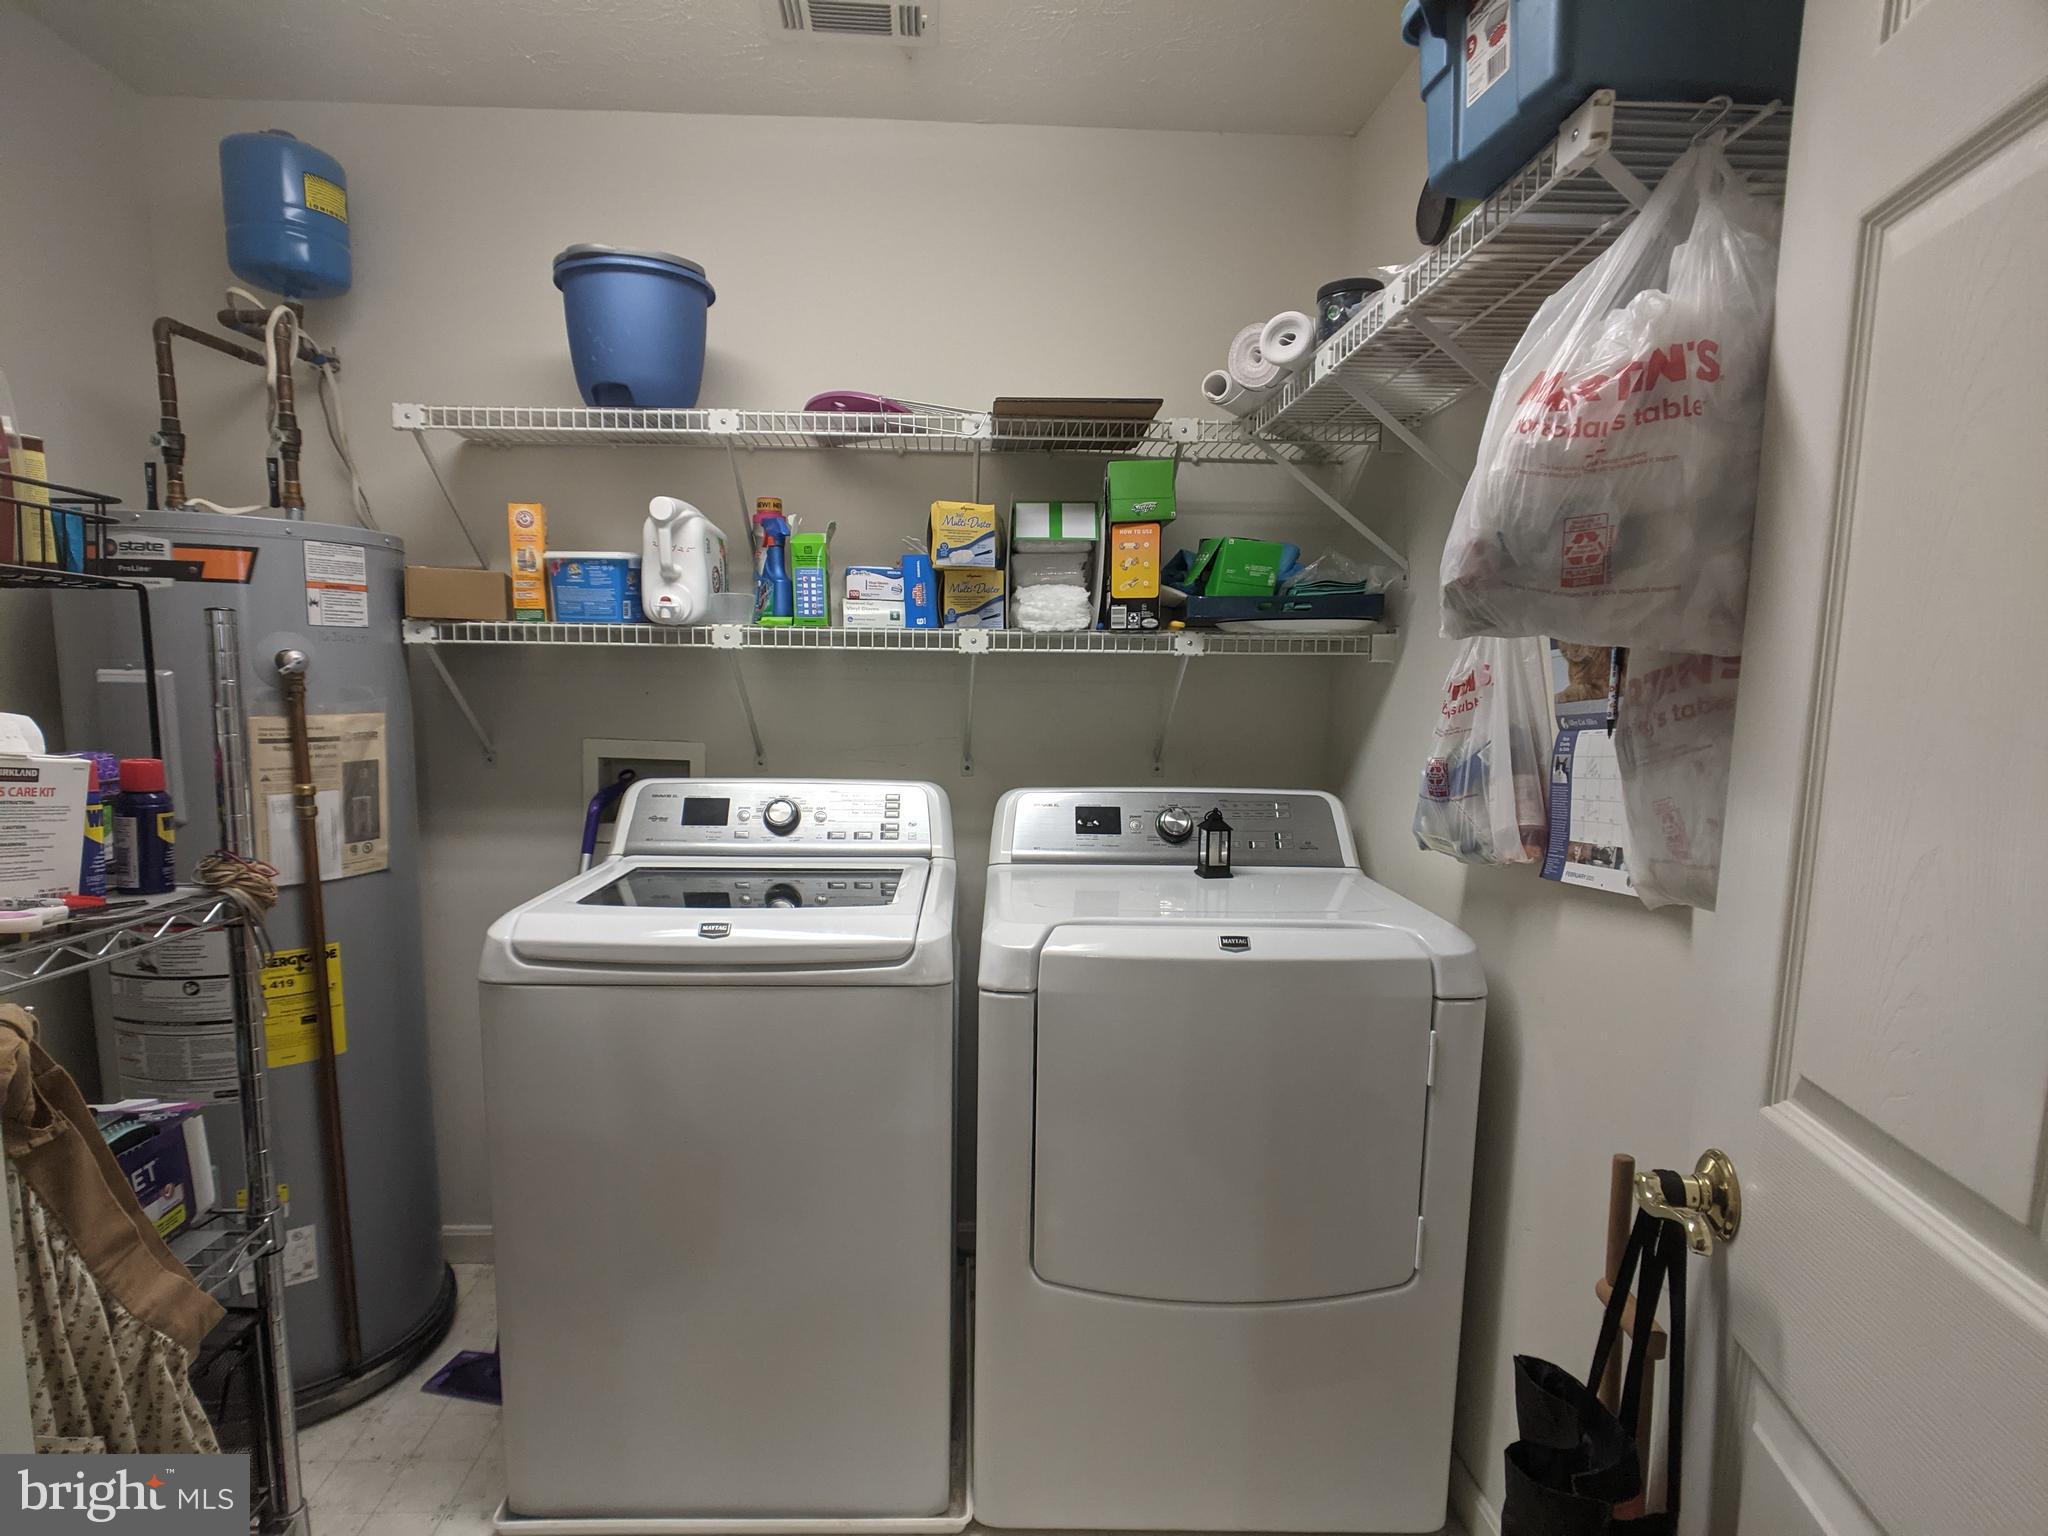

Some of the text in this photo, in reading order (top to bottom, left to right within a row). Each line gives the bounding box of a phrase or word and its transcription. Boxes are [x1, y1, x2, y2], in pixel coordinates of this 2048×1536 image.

[1633, 394, 1703, 427] table
[941, 514, 993, 528] Multi-Duster
[119, 541, 165, 552] state
[949, 582, 1001, 594] Multi-Duster
[8, 786, 38, 797] CARE
[39, 786, 57, 797] KIT
[270, 978, 295, 989] 419
